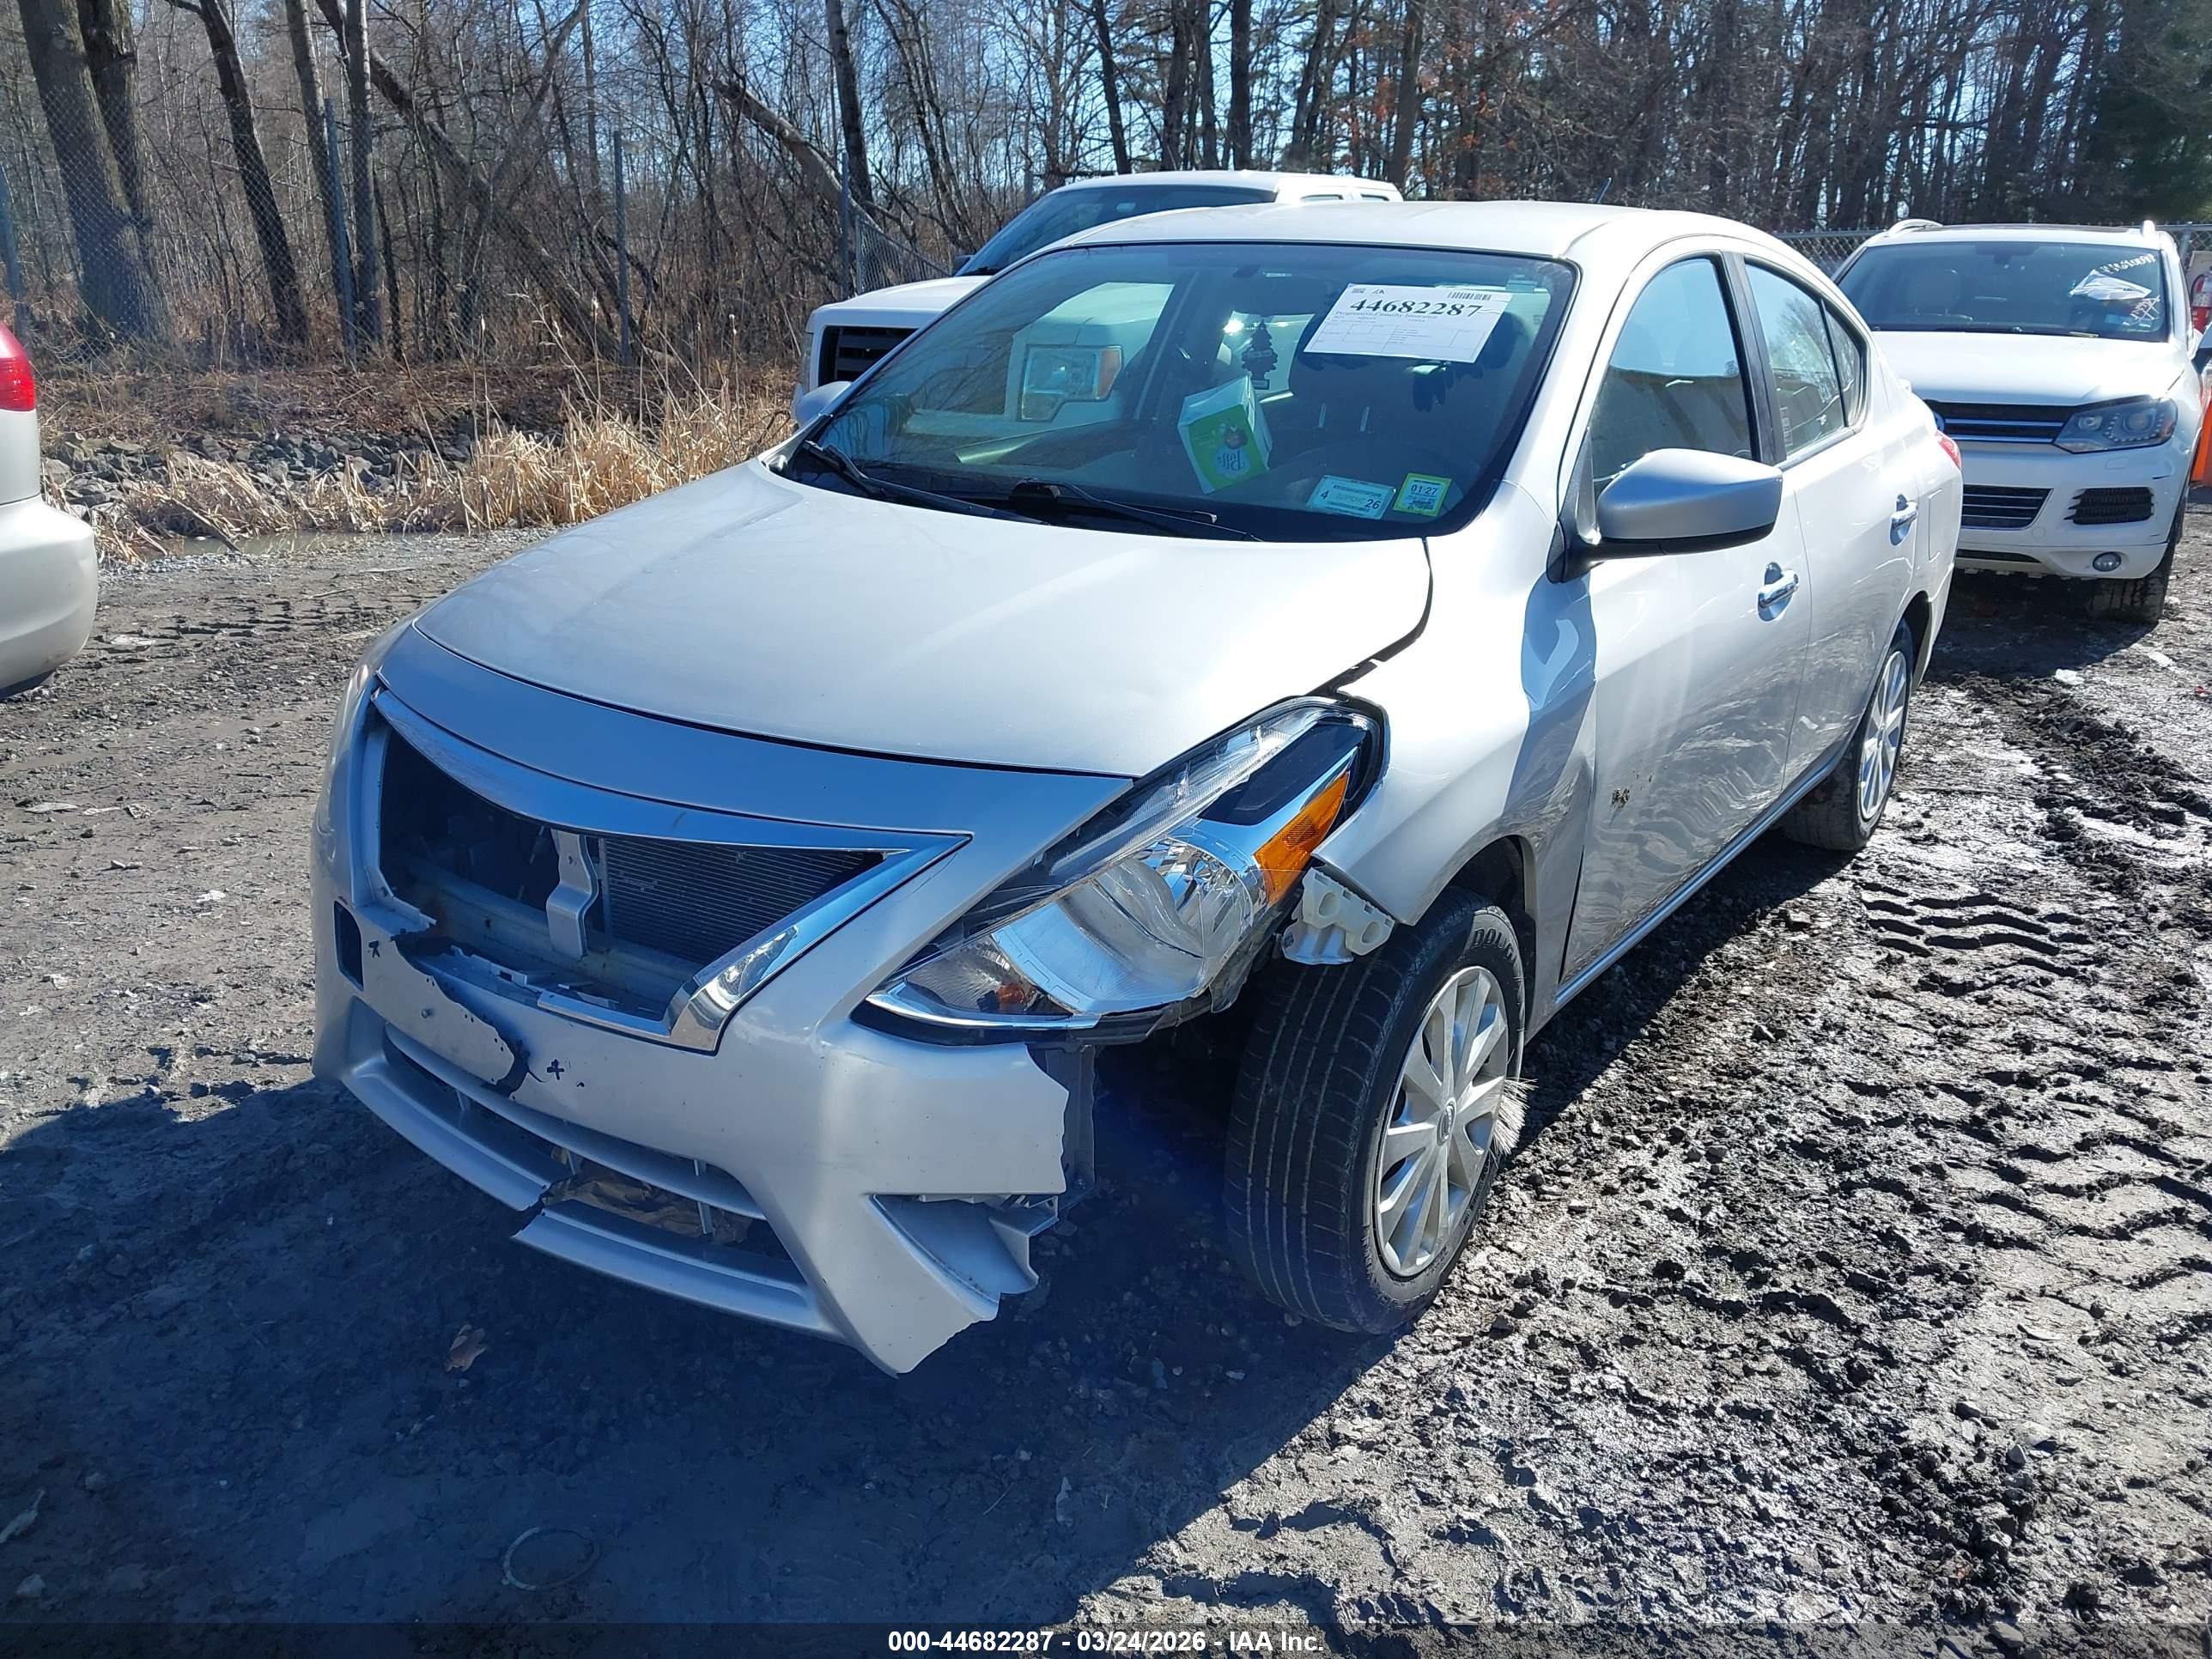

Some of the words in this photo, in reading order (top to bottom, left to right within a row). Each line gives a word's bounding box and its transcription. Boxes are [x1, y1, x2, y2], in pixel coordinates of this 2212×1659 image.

[1350, 297, 1484, 318] 44682287
[1320, 489, 1329, 500] 4
[1364, 498, 1382, 510] 26
